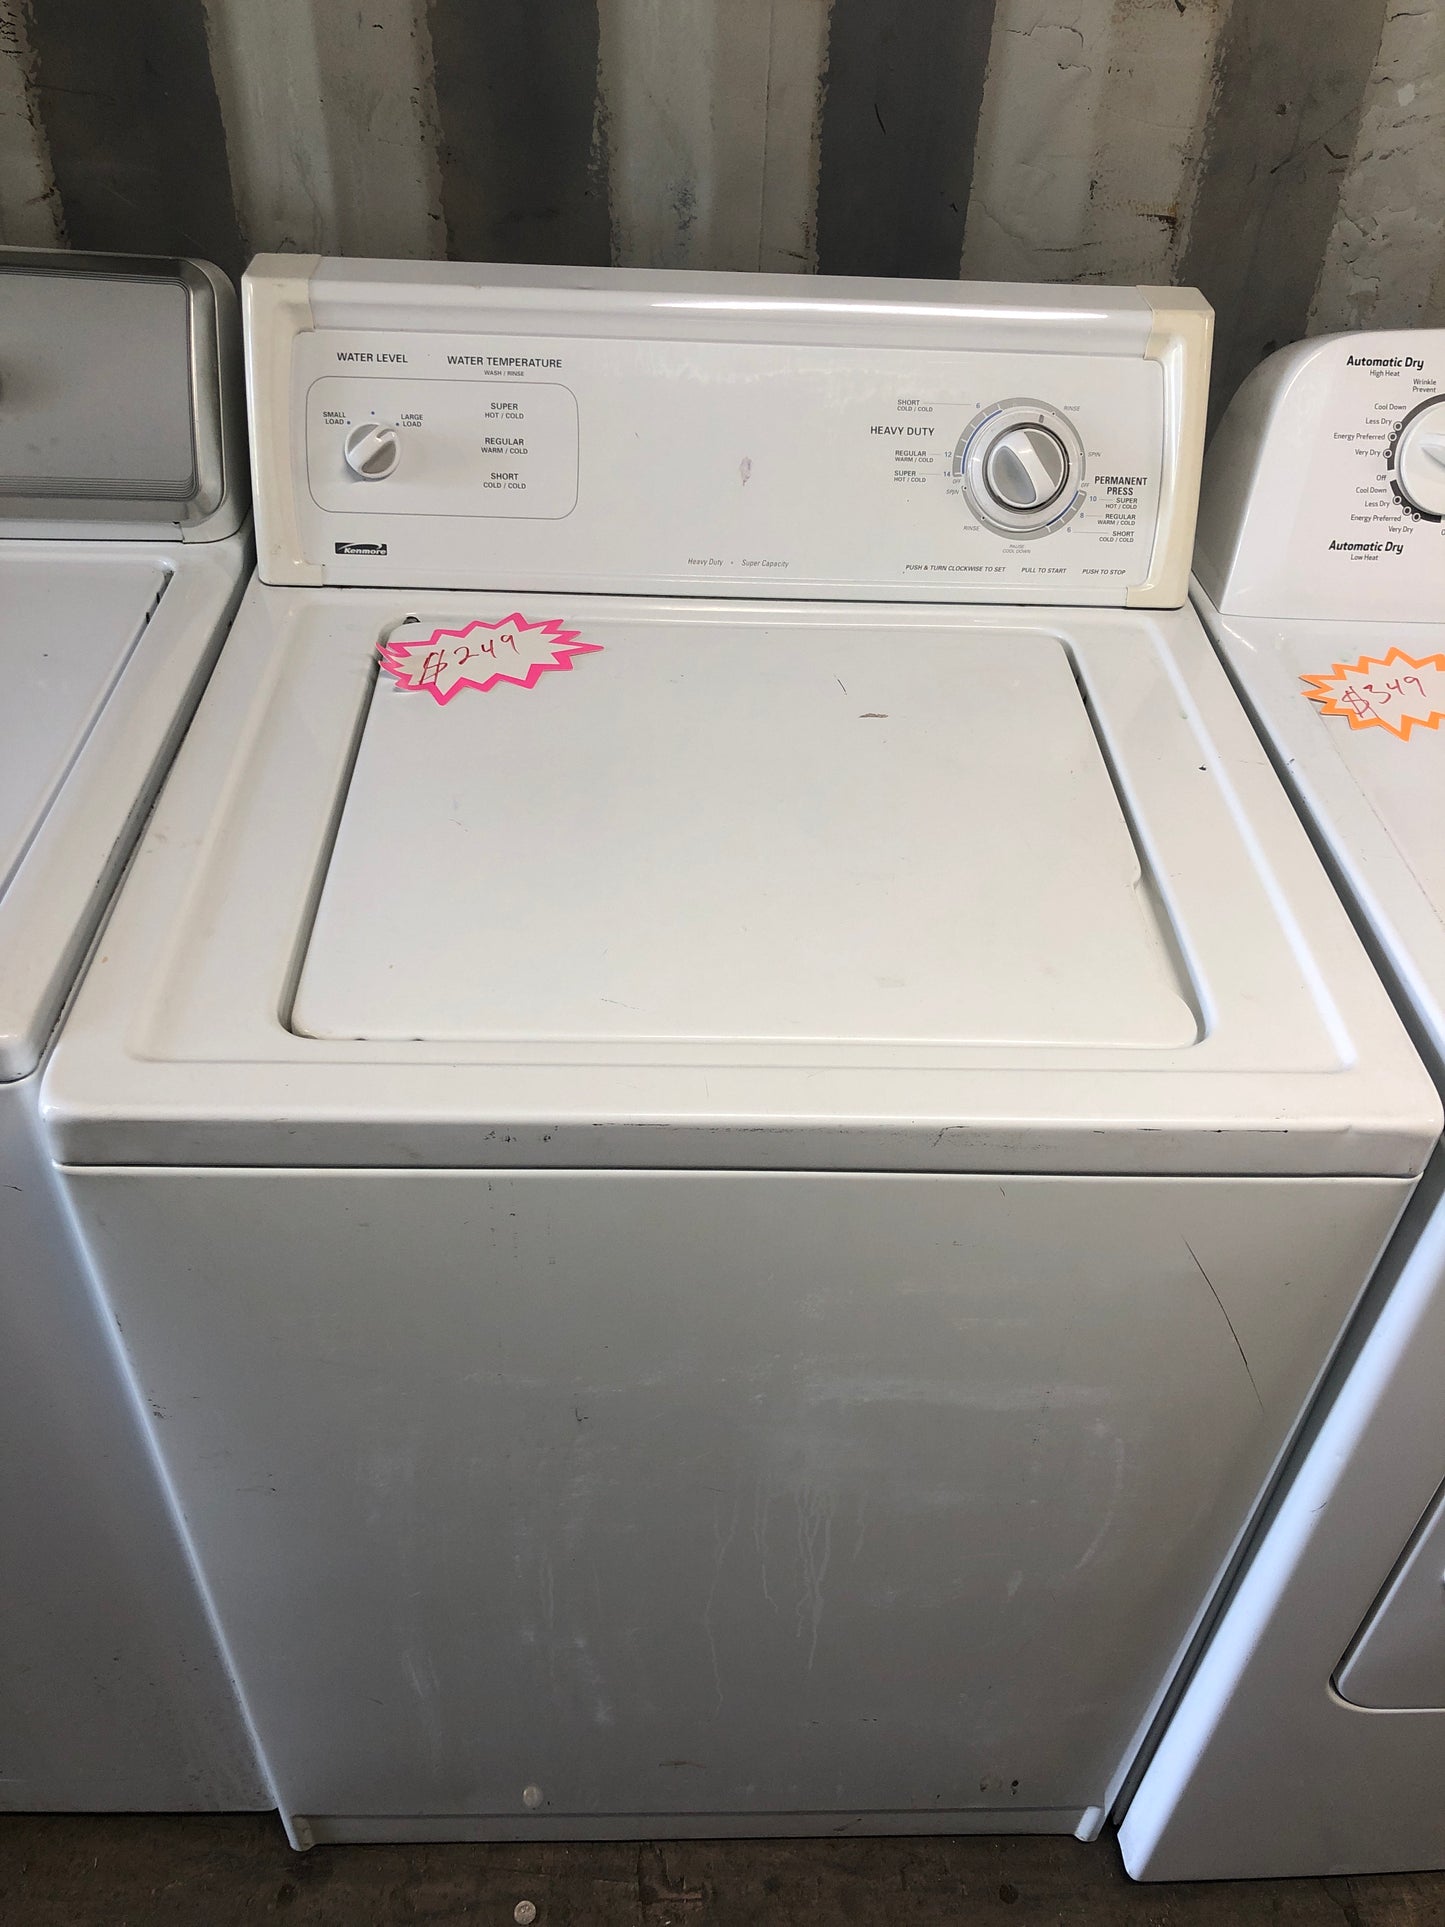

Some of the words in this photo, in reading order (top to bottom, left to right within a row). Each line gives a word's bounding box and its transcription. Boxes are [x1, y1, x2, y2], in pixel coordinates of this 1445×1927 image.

[337, 352, 373, 362] WATER
[376, 353, 408, 363] LEVEL
[447, 356, 484, 366] WATER
[486, 358, 562, 368] TEMPERATURE
[1346, 355, 1402, 367] Automatic
[1405, 357, 1424, 370] Dry
[1413, 378, 1437, 386] Wrinkle
[1374, 403, 1388, 411] Cool
[1380, 418, 1392, 426] Dry
[870, 426, 904, 435] HEAVY
[907, 427, 935, 436] DUTY
[1334, 433, 1354, 441] Energy
[1355, 449, 1368, 457] Very
[491, 473, 519, 481] SHORT
[1094, 476, 1147, 485] PERMANENT
[1107, 487, 1133, 495] PRESS
[1351, 514, 1372, 523] Energy
[1402, 526, 1413, 534] Dry
[1328, 540, 1383, 552] Automatic
[1385, 541, 1404, 555] Dry
[688, 558, 707, 566] Heavy
[742, 559, 760, 567] Super
[761, 560, 789, 568] Capacity
[419, 634, 520, 686] $249
[1342, 676, 1426, 720] $349
